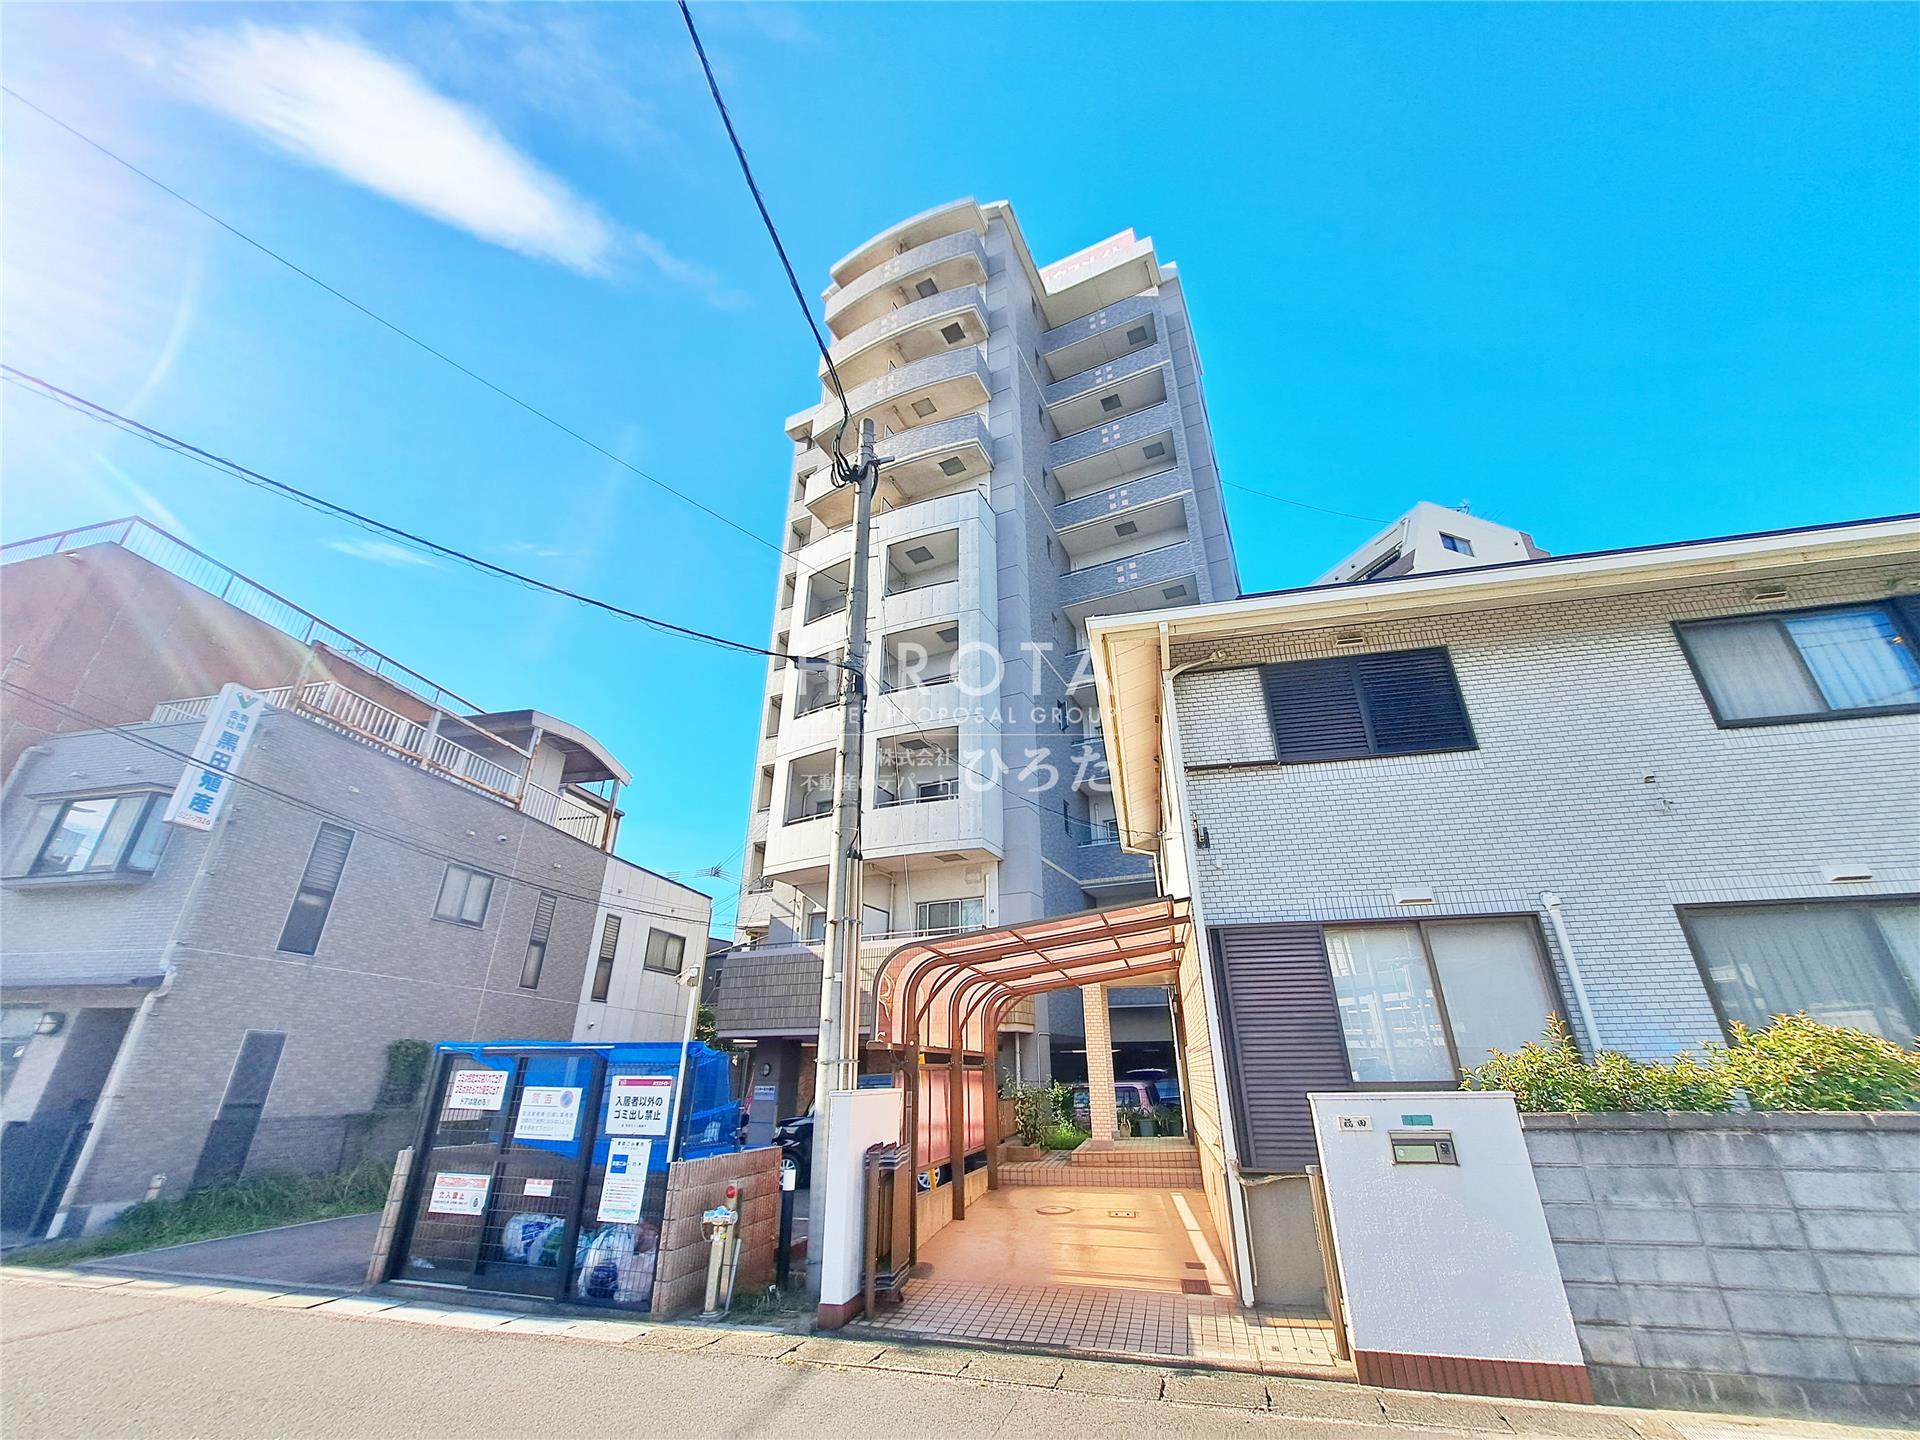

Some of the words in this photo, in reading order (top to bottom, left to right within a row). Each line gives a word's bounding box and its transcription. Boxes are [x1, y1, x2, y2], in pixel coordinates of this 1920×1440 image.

[615, 1096, 663, 1107] 入居者以外の
[613, 1110, 662, 1121] ゴミ出し禁止
